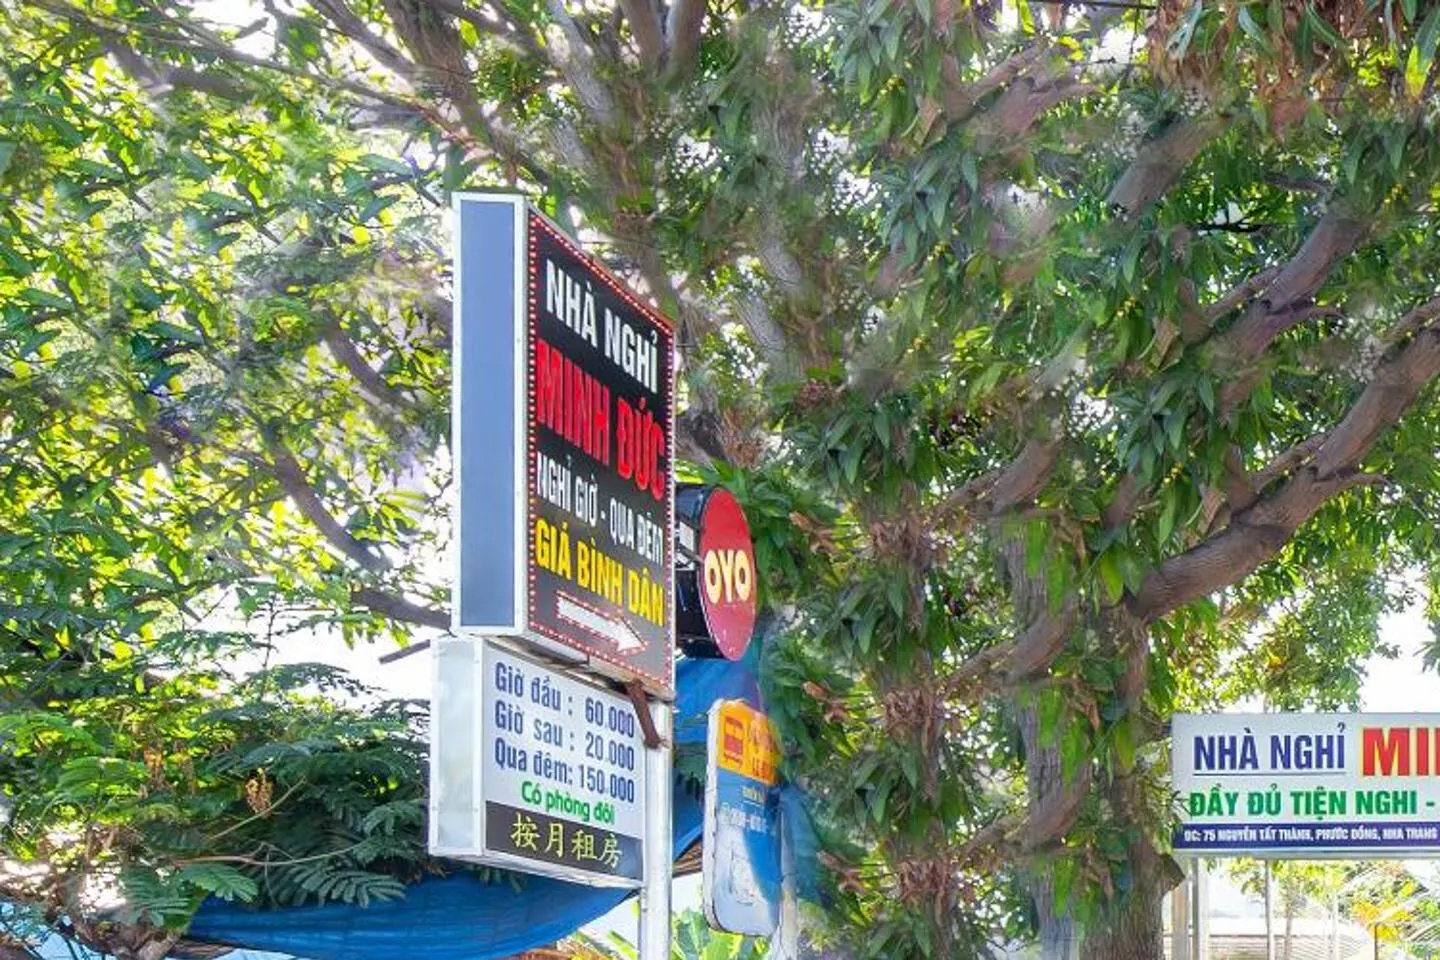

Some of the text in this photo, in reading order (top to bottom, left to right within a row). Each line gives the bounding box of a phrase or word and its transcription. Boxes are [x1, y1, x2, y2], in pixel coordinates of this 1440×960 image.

[546, 259, 658, 393] NHÀ NGHỈ
[535, 339, 666, 500] MINH ĐỨC
[537, 451, 572, 513] NGHỈ
[575, 473, 598, 527] GIỜ
[609, 497, 634, 550] QUA
[637, 511, 664, 567] ĐÊM
[535, 518, 665, 627] GIÁ BÌNH DÂN
[704, 549, 752, 604] OYO
[494, 662, 525, 698] Giờ
[531, 675, 562, 711] đầu
[585, 697, 635, 739] 60.000
[494, 700, 525, 735] Giờ
[533, 719, 563, 748] sau
[585, 731, 635, 772] 20.000
[494, 737, 527, 772] Qua
[578, 764, 635, 804] 150.000
[1193, 727, 1259, 771] NHÀ
[1270, 721, 1346, 770] NGHỈ
[521, 781, 542, 805] Có
[1188, 783, 1239, 817] ĐẦY
[1247, 783, 1282, 816] ĐỦ
[1290, 786, 1347, 820] TIỆN
[1355, 790, 1418, 815] NGHI
[510, 812, 624, 869] 按月租房
